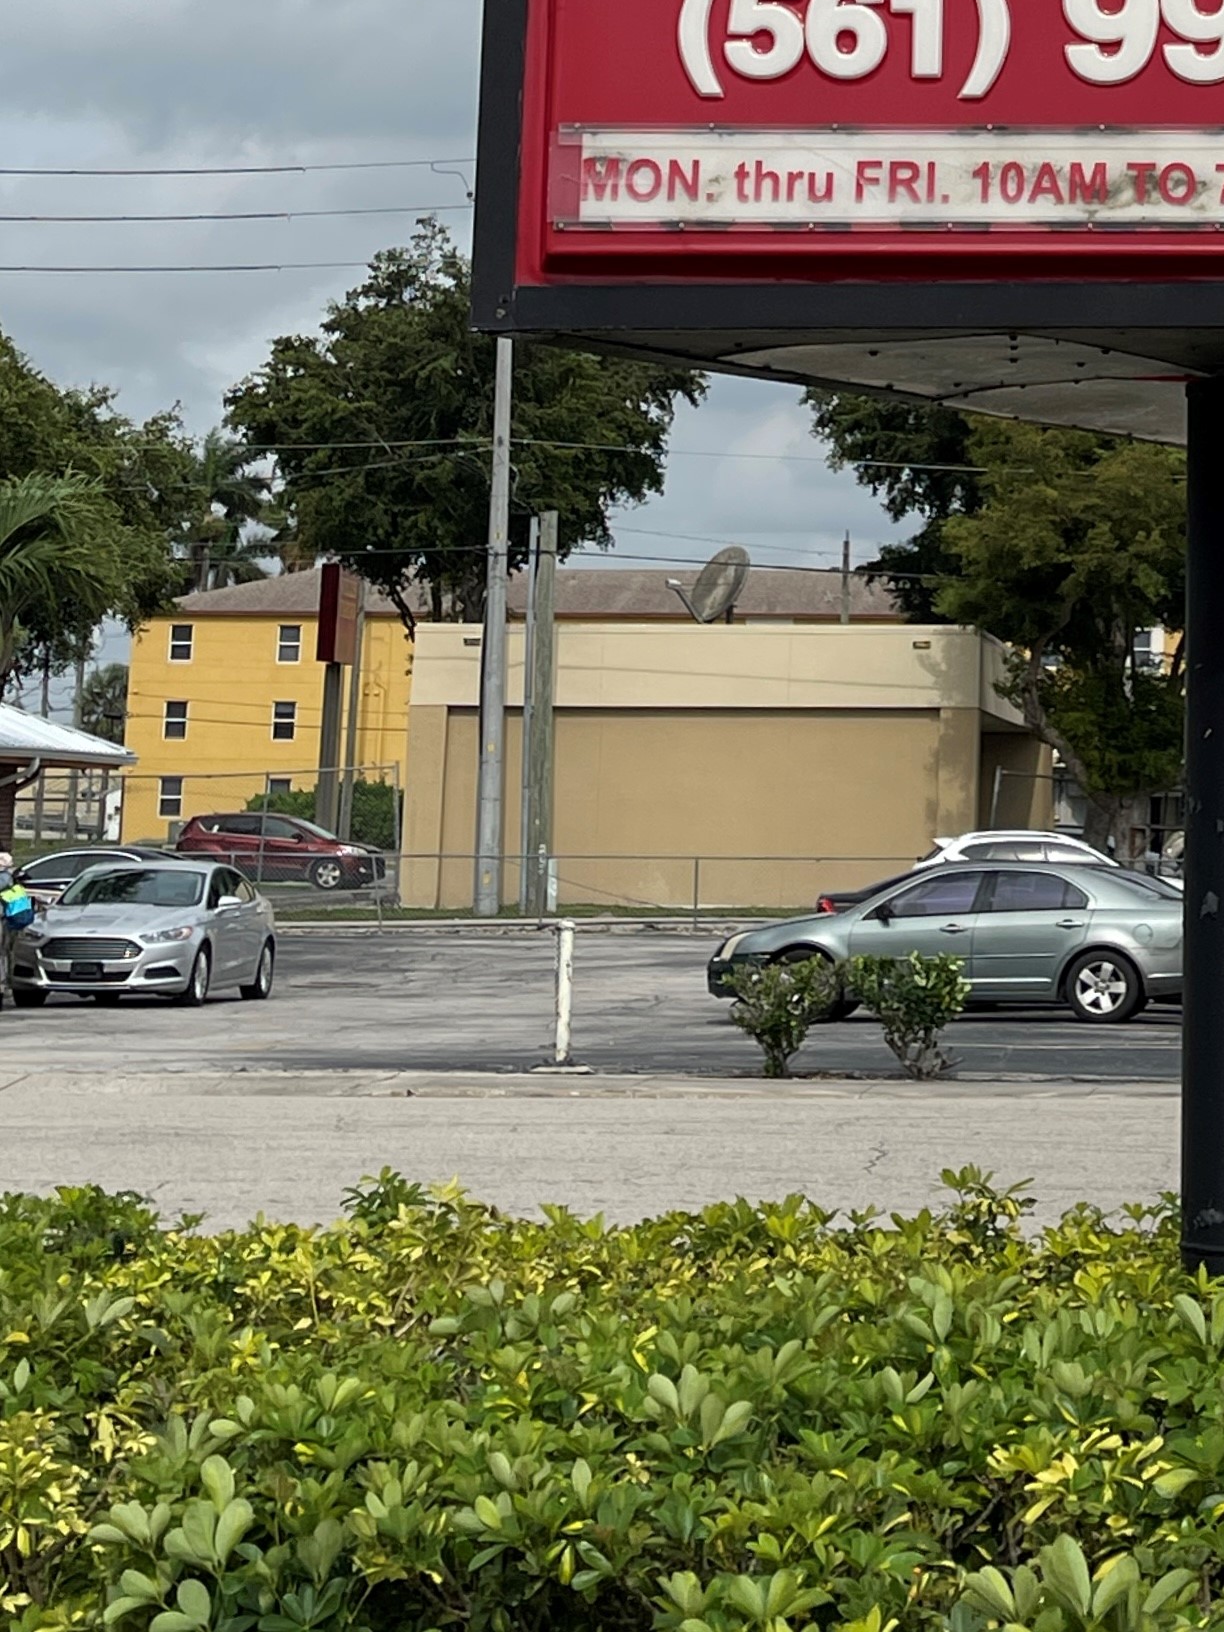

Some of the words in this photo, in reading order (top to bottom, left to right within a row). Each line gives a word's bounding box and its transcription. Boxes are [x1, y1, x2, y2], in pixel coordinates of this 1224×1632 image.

[581, 156, 714, 203] MON.
[733, 158, 836, 202] thru
[853, 158, 949, 203] FRI.
[971, 160, 1110, 204] 10AM
[1125, 160, 1198, 205] TO
